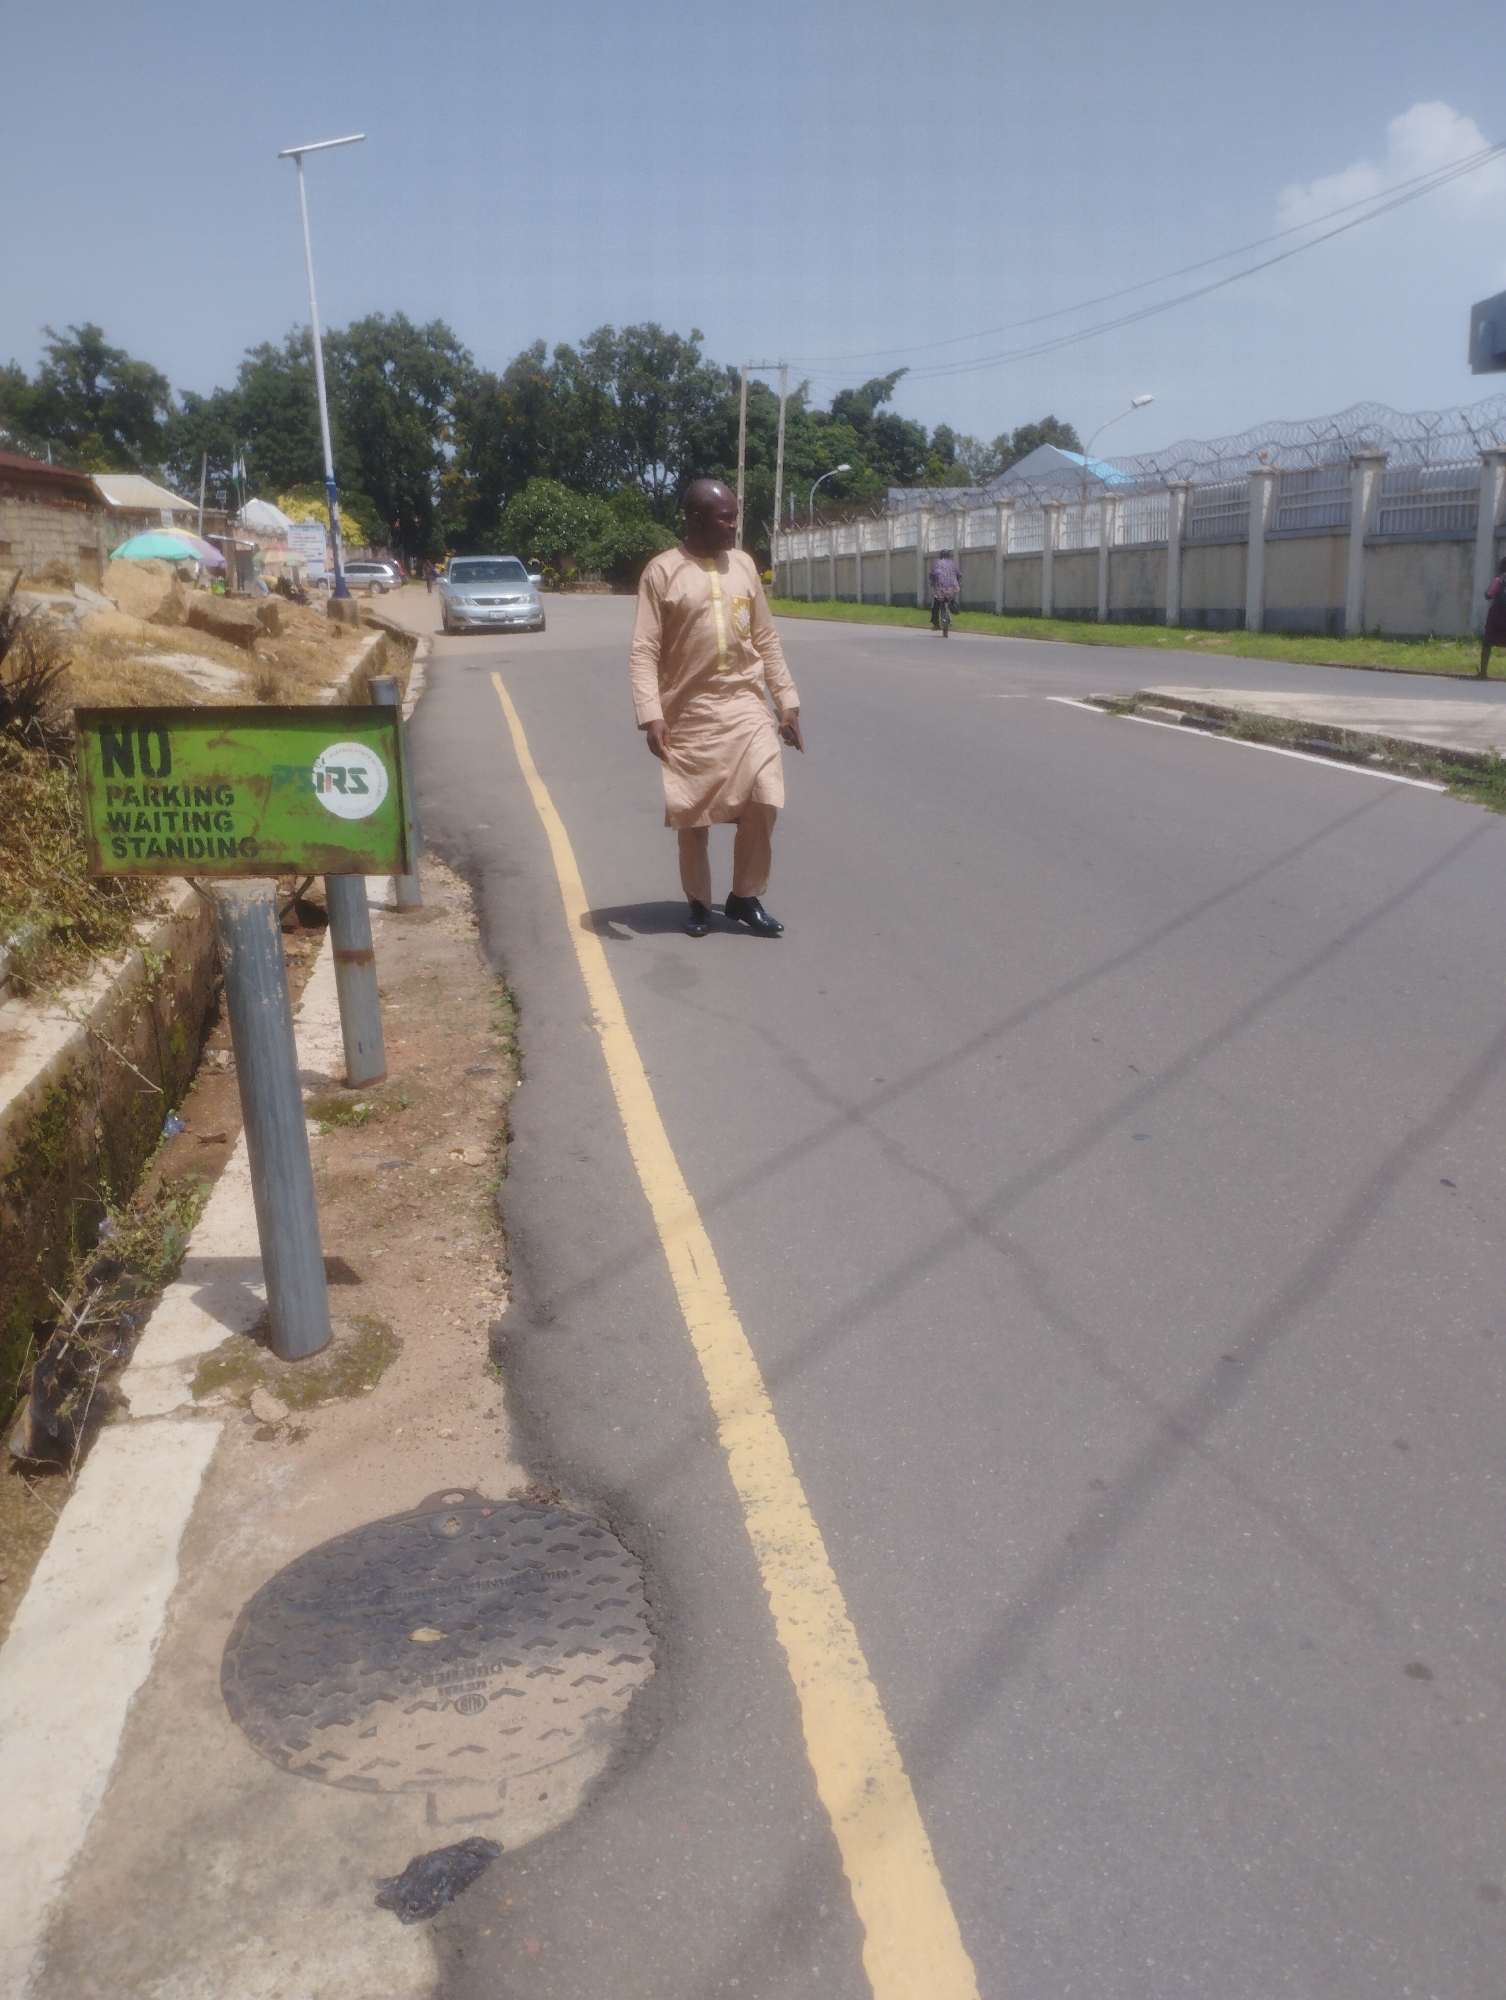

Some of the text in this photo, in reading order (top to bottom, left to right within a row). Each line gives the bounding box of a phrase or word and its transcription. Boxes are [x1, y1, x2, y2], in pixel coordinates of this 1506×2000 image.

[100, 724, 172, 778] NO
[106, 784, 235, 808] PARKING
[107, 810, 235, 833] WAITING
[111, 836, 259, 860] STANDING
